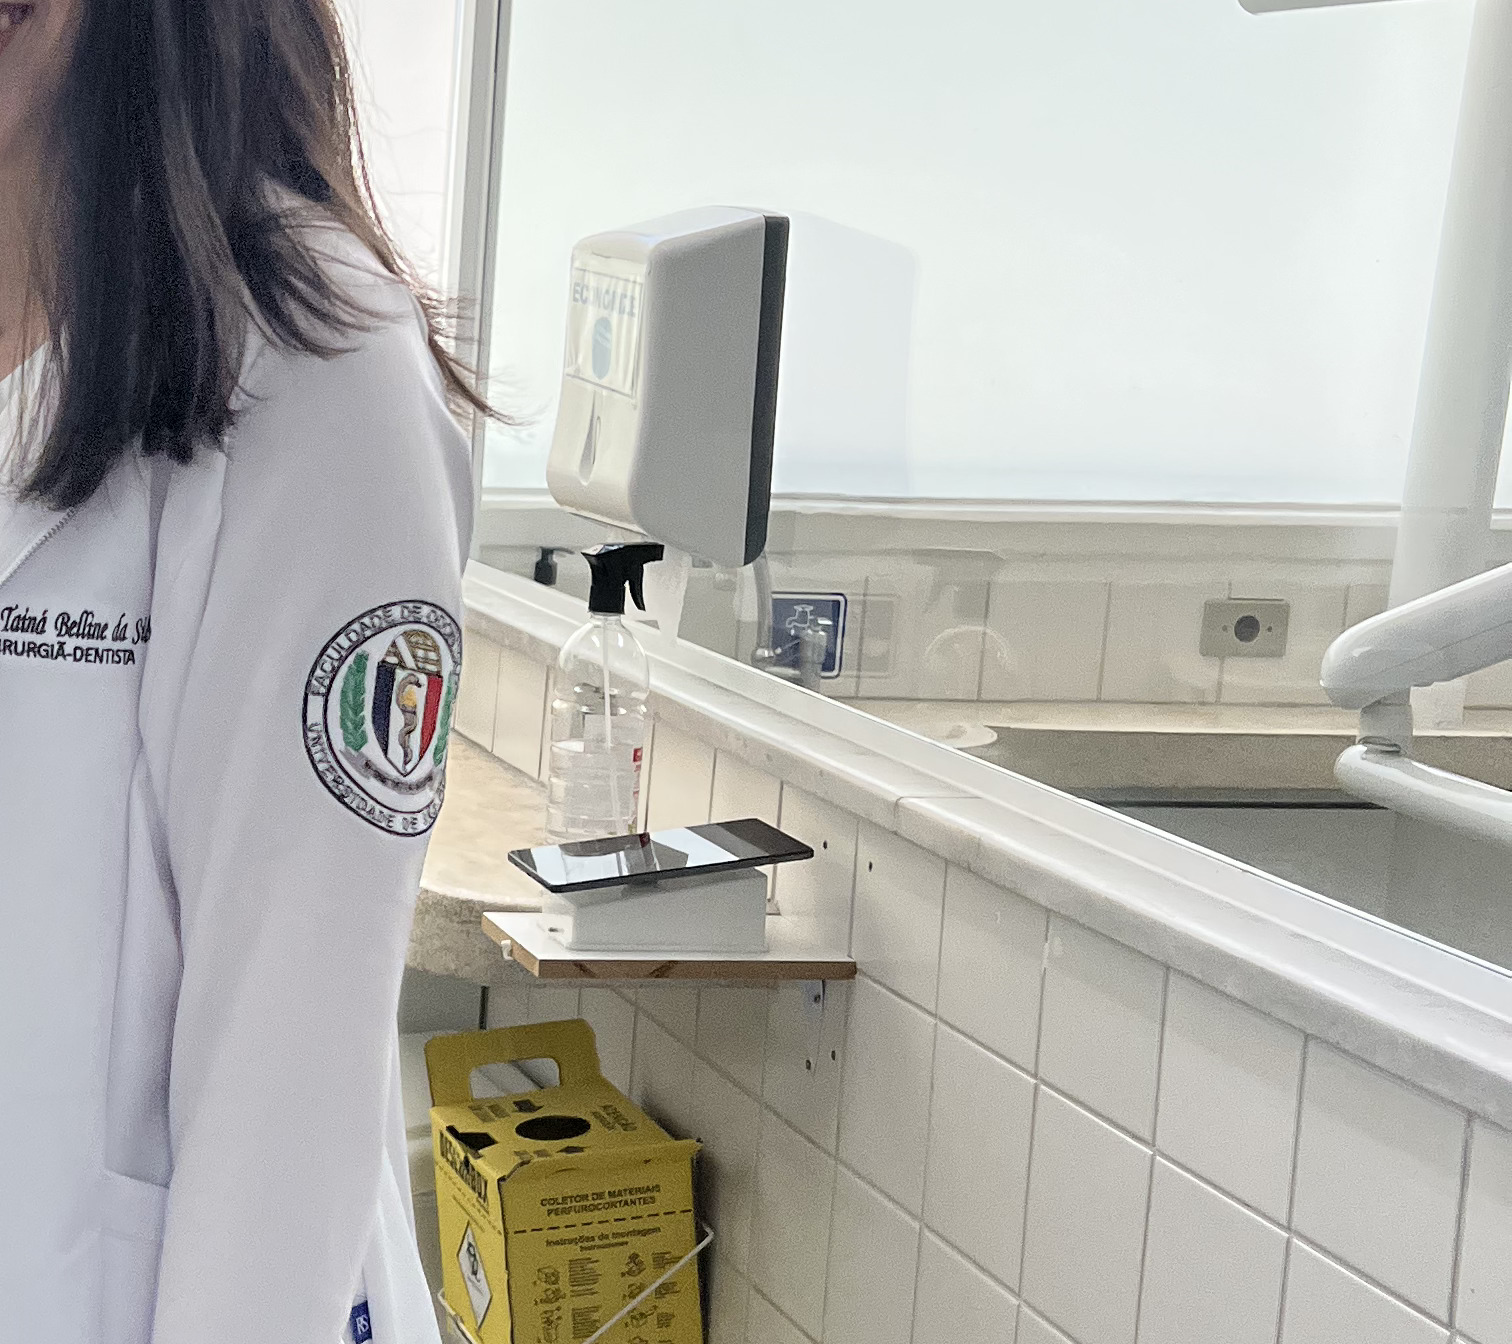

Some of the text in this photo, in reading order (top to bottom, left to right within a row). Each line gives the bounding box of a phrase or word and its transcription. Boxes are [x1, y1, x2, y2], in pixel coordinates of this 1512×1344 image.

[111, 612, 128, 642] da
[309, 606, 393, 696] FACULDADE
[400, 605, 422, 622] DE
[308, 722, 395, 829] UNIVERSIDADE
[540, 1184, 661, 1207] COLETOR DE MATERIAIS
[547, 1196, 656, 1217] PERFUROCORTANTES
